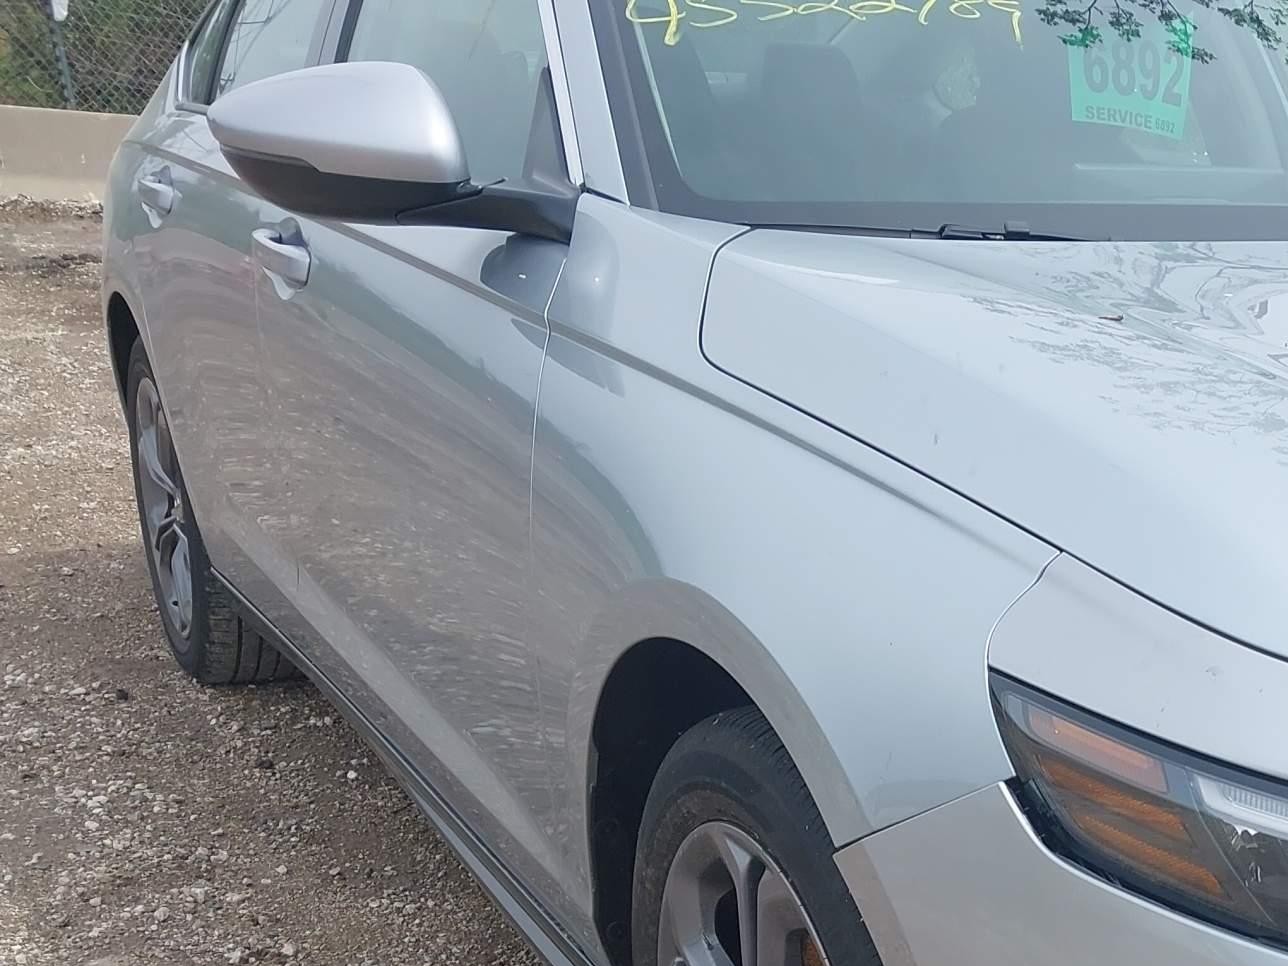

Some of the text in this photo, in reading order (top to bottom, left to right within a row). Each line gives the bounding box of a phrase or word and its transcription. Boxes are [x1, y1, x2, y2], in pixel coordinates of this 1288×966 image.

[1083, 40, 1185, 107] 6892
[1085, 105, 1176, 134] SERVICE 6892
